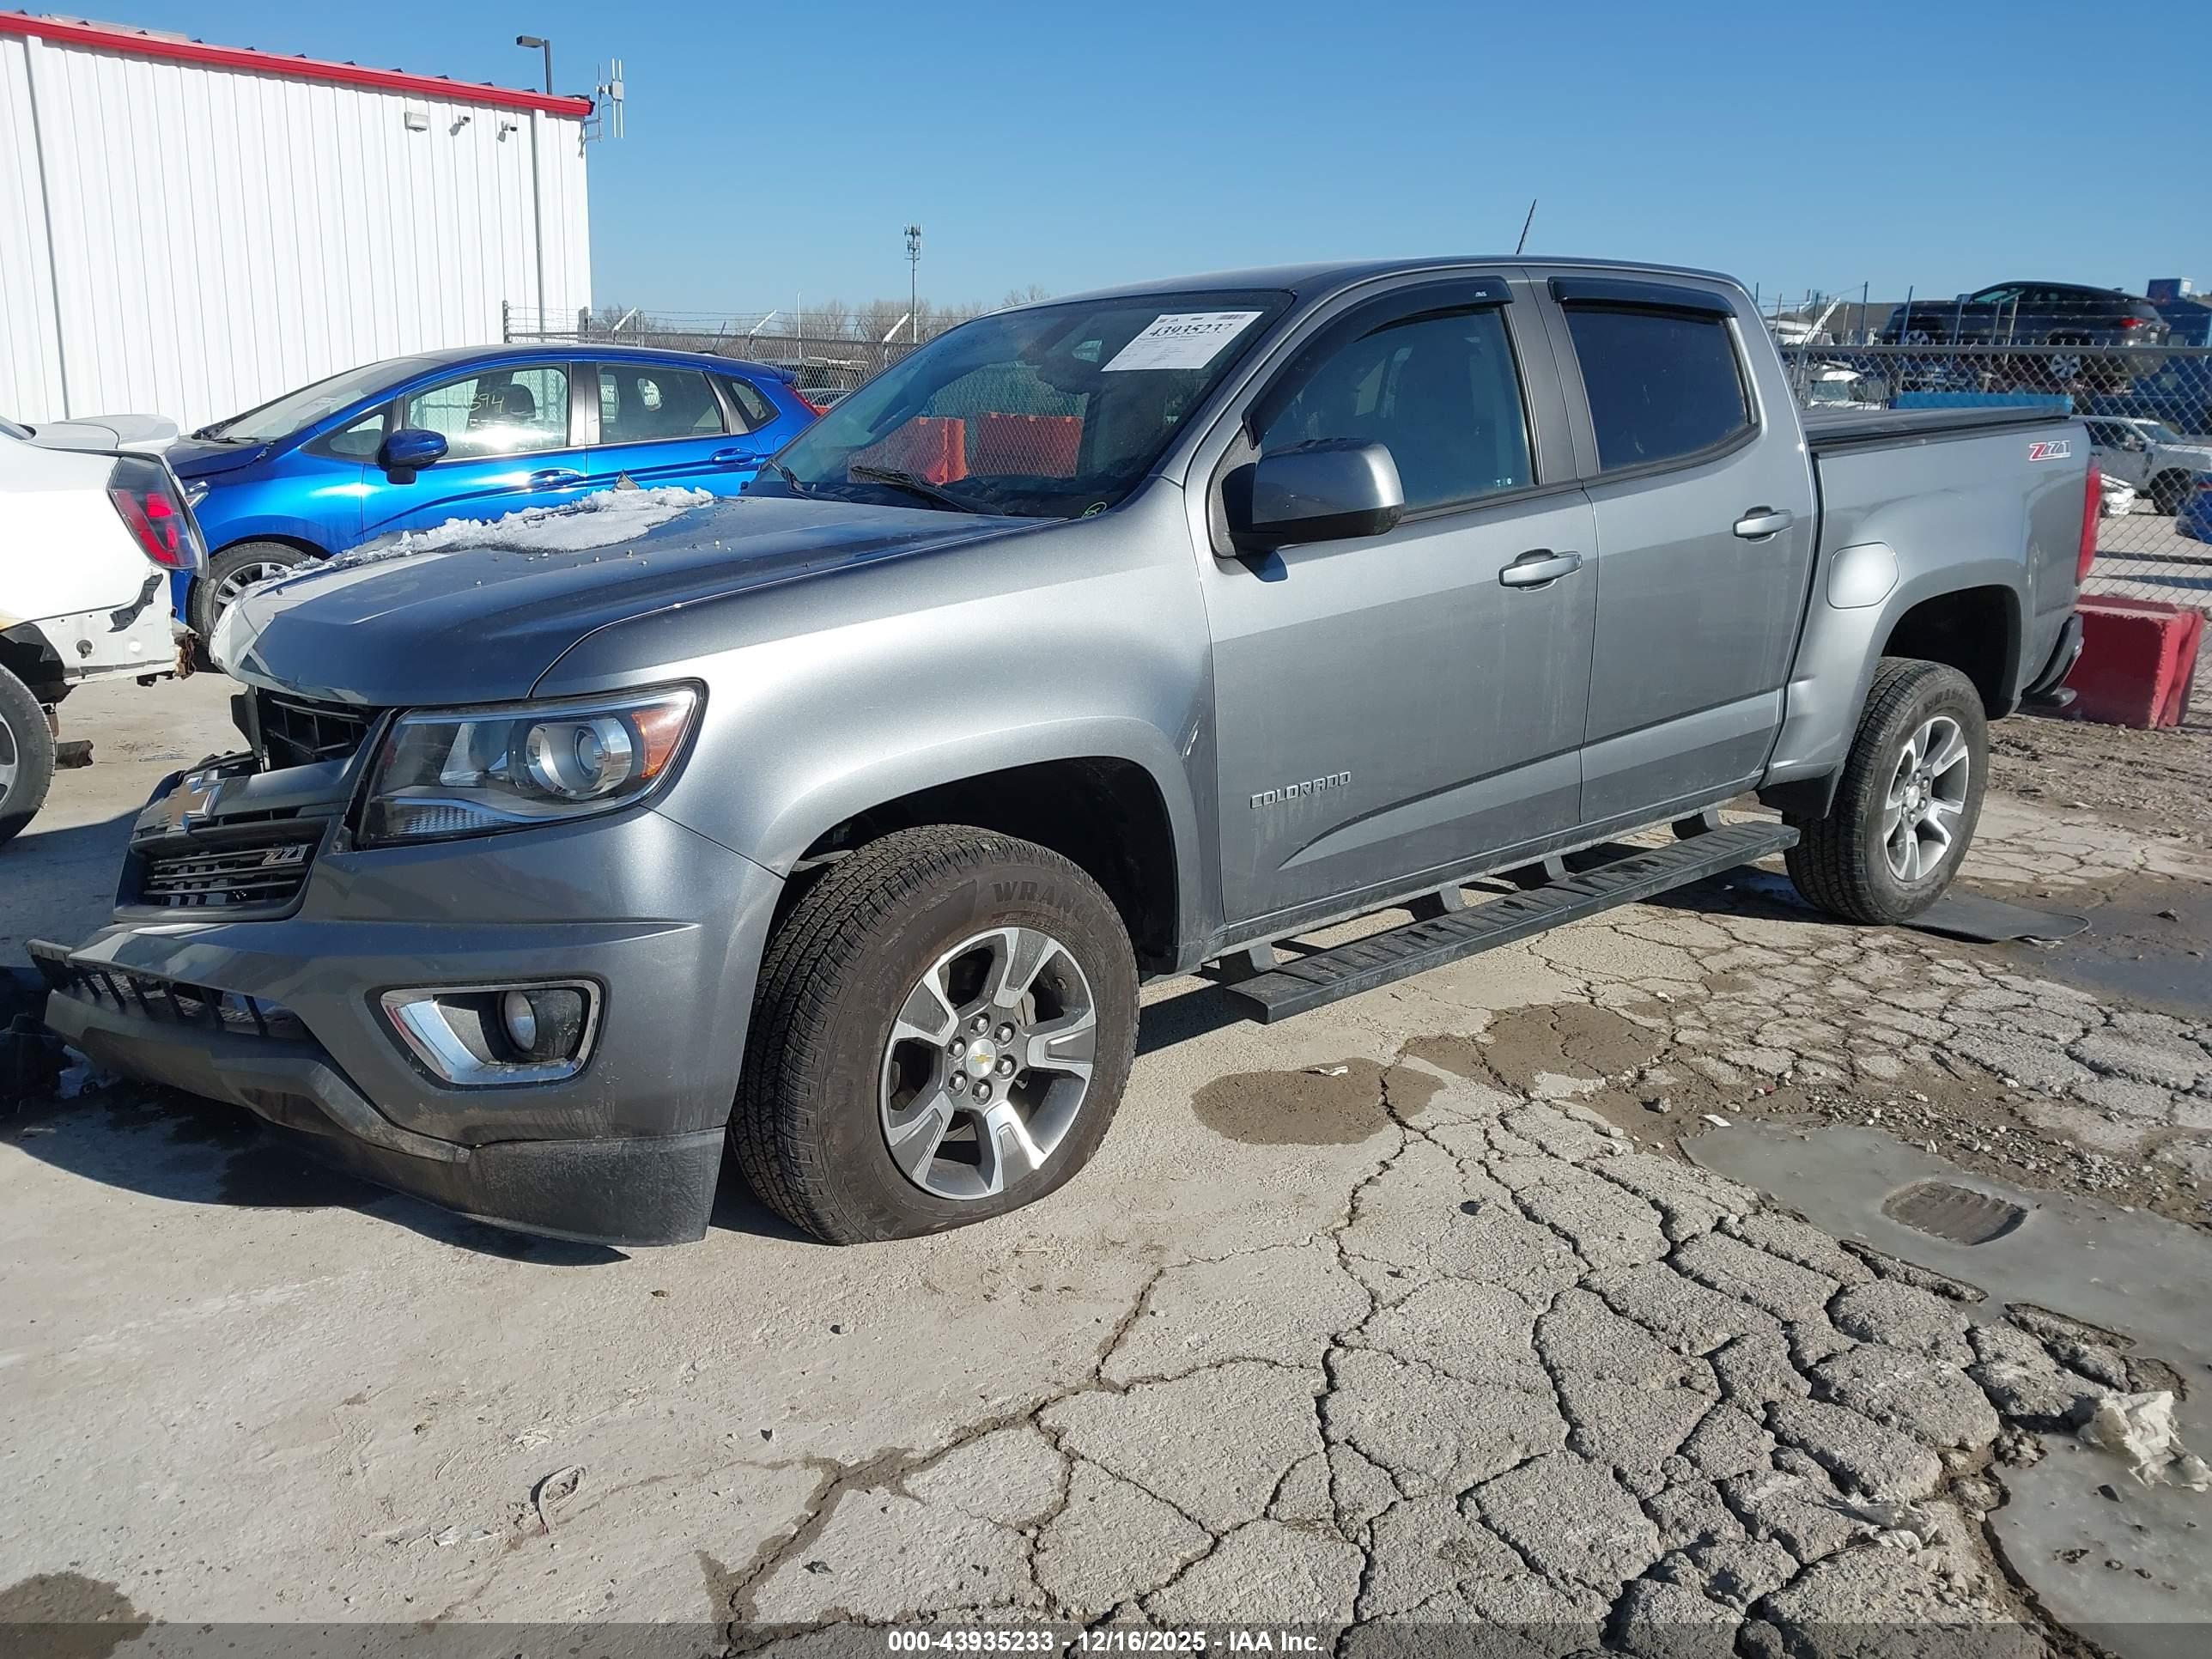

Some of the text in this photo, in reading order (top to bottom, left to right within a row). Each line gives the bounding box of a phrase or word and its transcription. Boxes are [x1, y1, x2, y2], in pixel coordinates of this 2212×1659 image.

[2028, 440, 2071, 461] Z71
[1250, 771, 1352, 809] COLORADO
[261, 843, 309, 866] Z71
